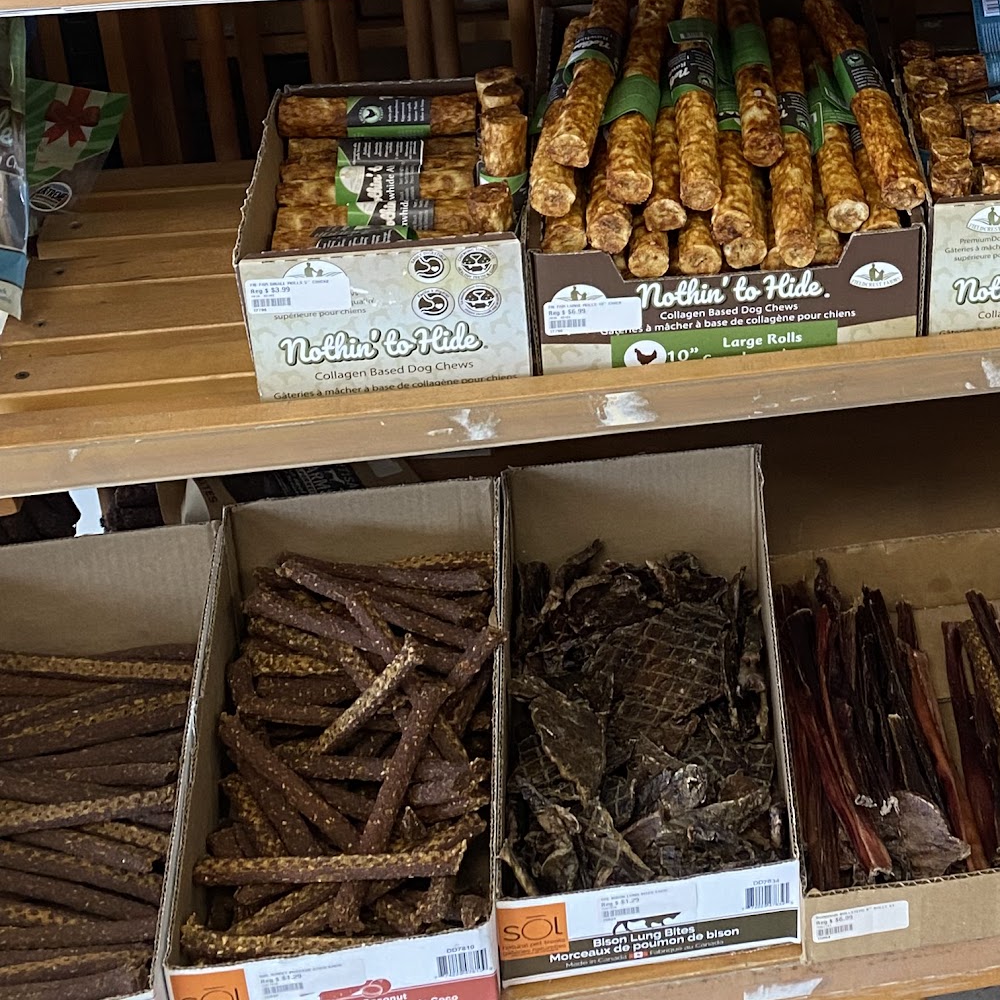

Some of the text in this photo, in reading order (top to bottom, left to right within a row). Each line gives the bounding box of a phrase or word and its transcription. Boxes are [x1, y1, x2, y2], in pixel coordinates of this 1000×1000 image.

[636, 270, 823, 309] Nothin' to Hide
[279, 321, 483, 366] Nothin' to Hide
[722, 332, 803, 349] Large Rolls
[314, 360, 474, 382] Collagen Based Dog Chews
[550, 948, 611, 963] Morceaux
[614, 944, 630, 953] de
[633, 936, 685, 952] poumon
[687, 933, 704, 942] de
[706, 927, 740, 940] bison
[593, 925, 696, 947] Bison Lung Bites
